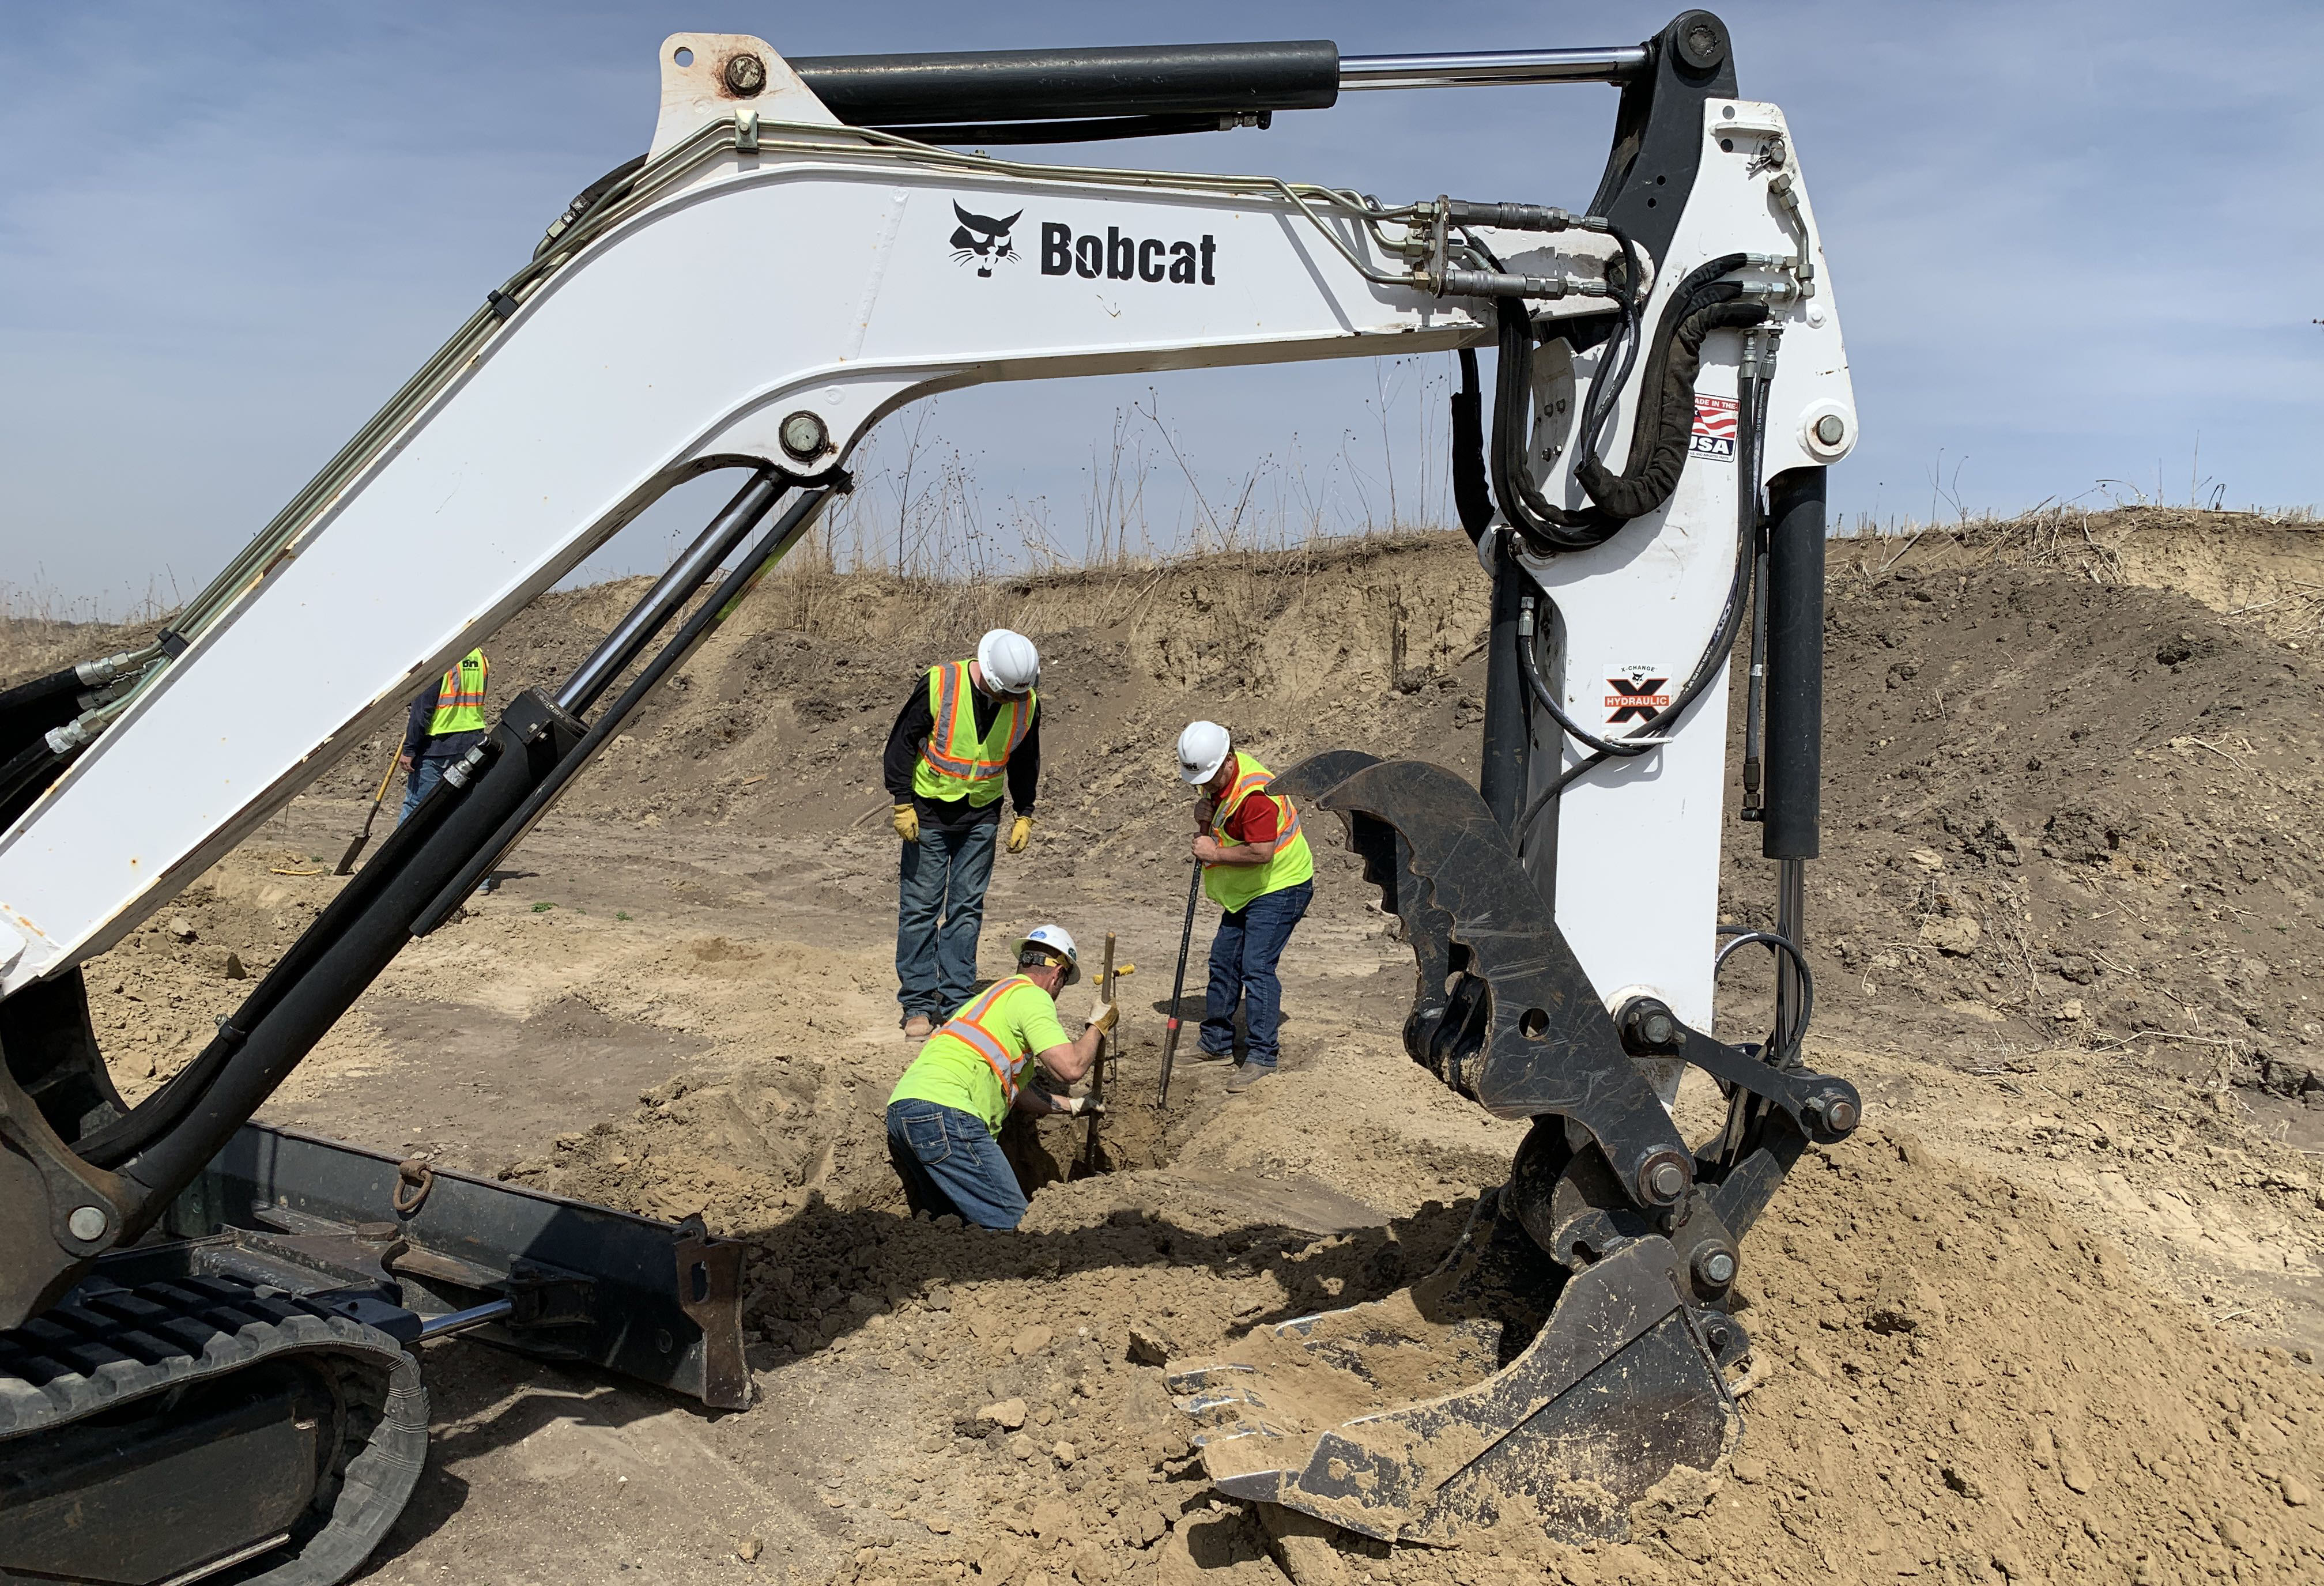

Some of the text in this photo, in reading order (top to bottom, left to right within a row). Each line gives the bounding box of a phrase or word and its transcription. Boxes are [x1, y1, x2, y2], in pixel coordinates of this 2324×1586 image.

[1042, 222, 1217, 286] Bobcat
[1695, 398, 1710, 406] ADE
[1606, 697, 1667, 706] HYDRAULIC
